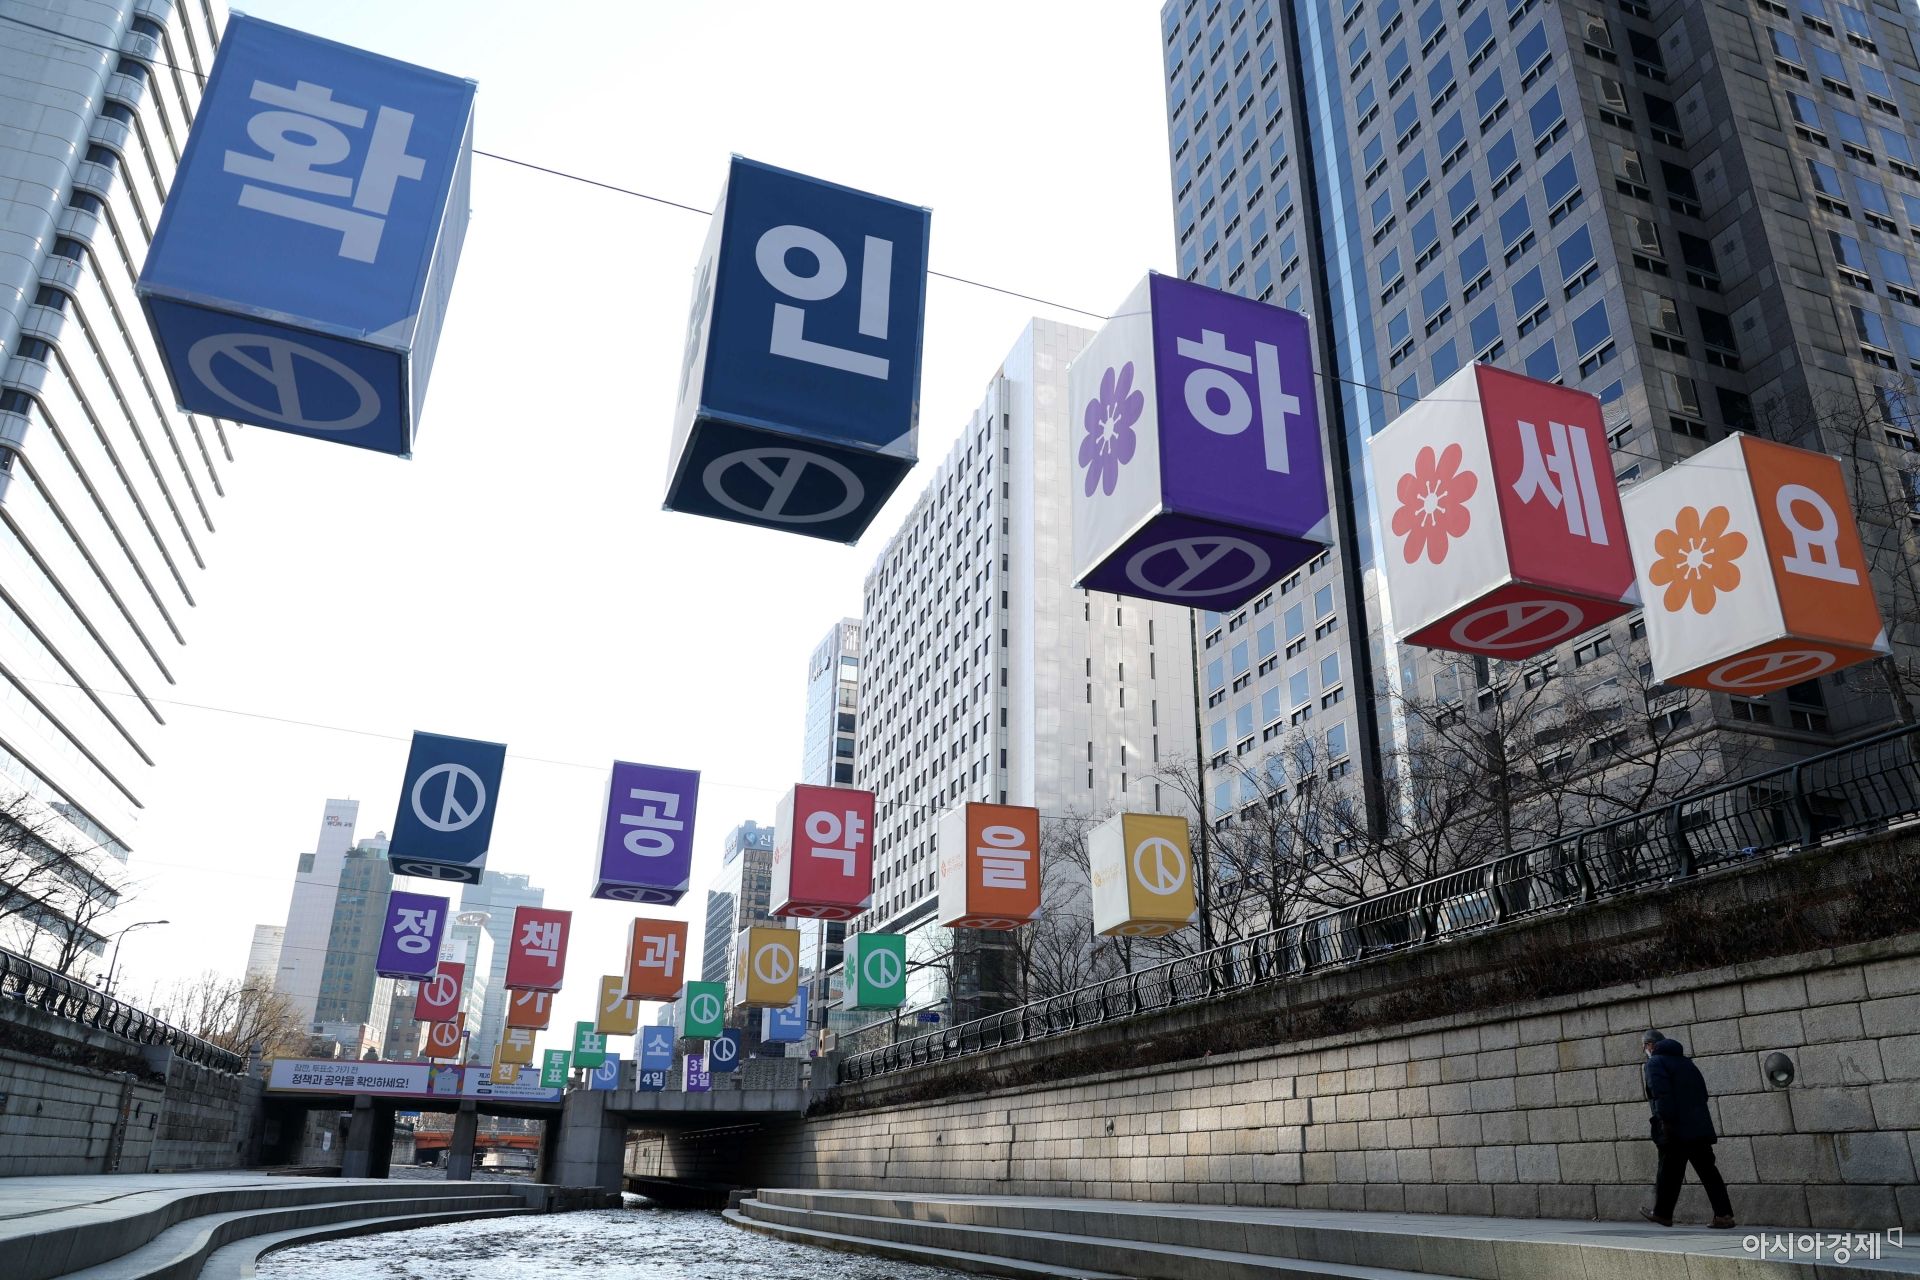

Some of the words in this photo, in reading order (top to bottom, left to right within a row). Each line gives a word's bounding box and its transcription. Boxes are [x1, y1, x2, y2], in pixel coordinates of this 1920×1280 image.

[223, 80, 426, 264] 확
[755, 224, 894, 381] 인
[1176, 328, 1301, 475] 하
[1512, 420, 1609, 545] 세
[1775, 484, 1860, 585] 요
[619, 788, 684, 857] 공
[805, 810, 865, 877] 약
[976, 825, 1031, 890] 을
[393, 908, 437, 954] 정
[519, 920, 562, 967] 책
[638, 933, 680, 977] 과
[507, 1029, 532, 1052] 투
[579, 1030, 602, 1054] 표
[646, 1033, 670, 1057] 소
[292, 1073, 322, 1085] 정책과
[324, 1075, 355, 1086] 공약을
[356, 1076, 409, 1089] 확인하세요!
[312, 1064, 334, 1073] 투표소
[642, 1071, 663, 1087] 4일
[689, 1072, 710, 1087] 5일
